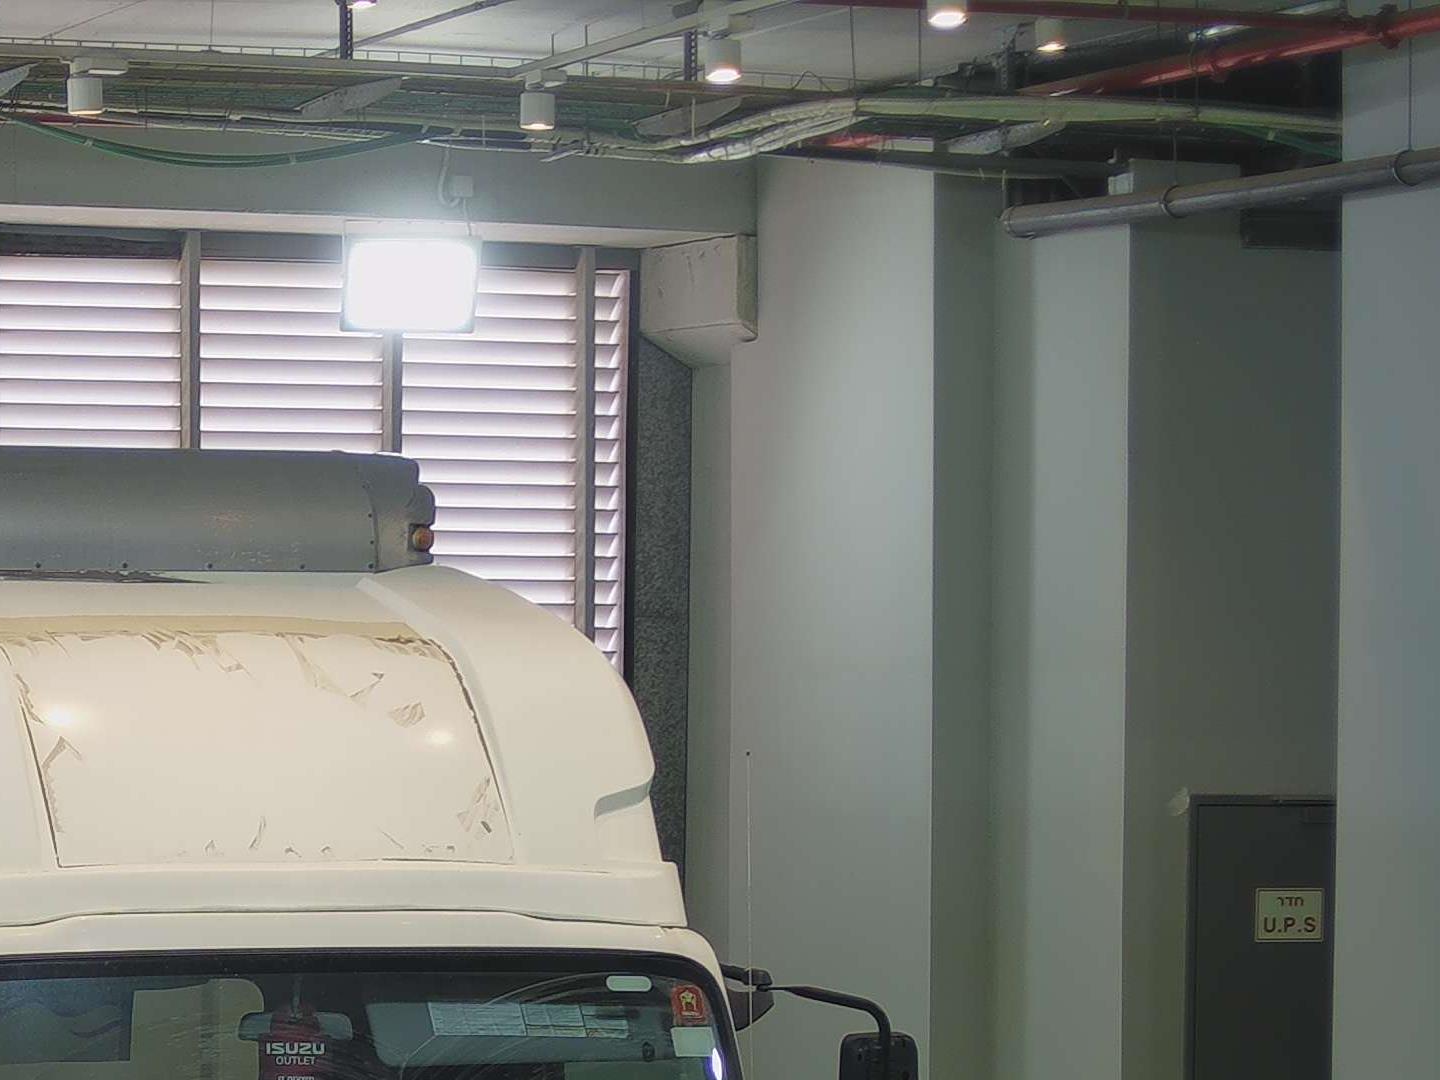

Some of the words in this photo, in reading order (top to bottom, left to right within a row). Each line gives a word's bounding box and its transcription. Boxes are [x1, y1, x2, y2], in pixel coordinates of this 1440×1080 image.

[1276, 896, 1305, 907] חדר
[1263, 916, 1317, 933] U.P.S
[265, 1042, 325, 1055] ISUZU
[275, 1056, 316, 1065] OUTLET
